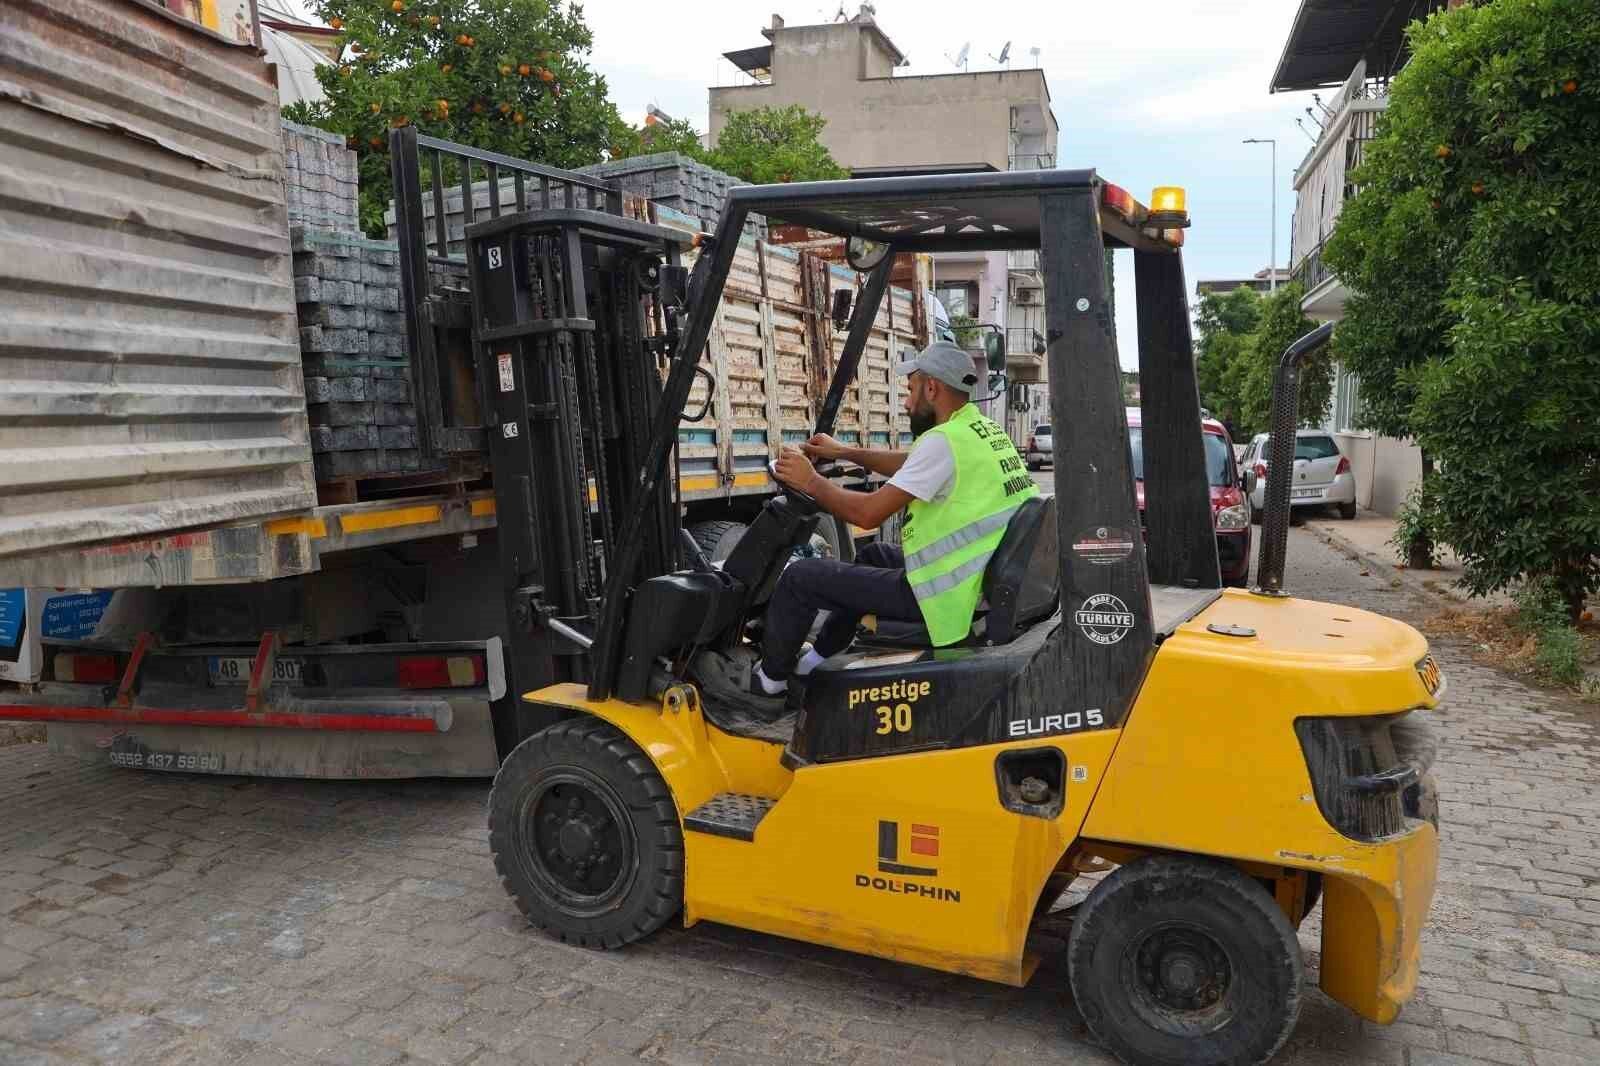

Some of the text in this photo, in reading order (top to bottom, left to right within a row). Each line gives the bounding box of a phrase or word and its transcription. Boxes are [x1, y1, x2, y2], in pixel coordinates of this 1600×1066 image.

[1079, 612, 1130, 625] TÜRKİYE
[221, 660, 239, 678] 48
[849, 679, 930, 709] prestige
[875, 703, 912, 735] 30
[1010, 709, 1104, 737] EURO 5
[147, 753, 174, 768] 437
[855, 874, 961, 903] DOLPHIN
